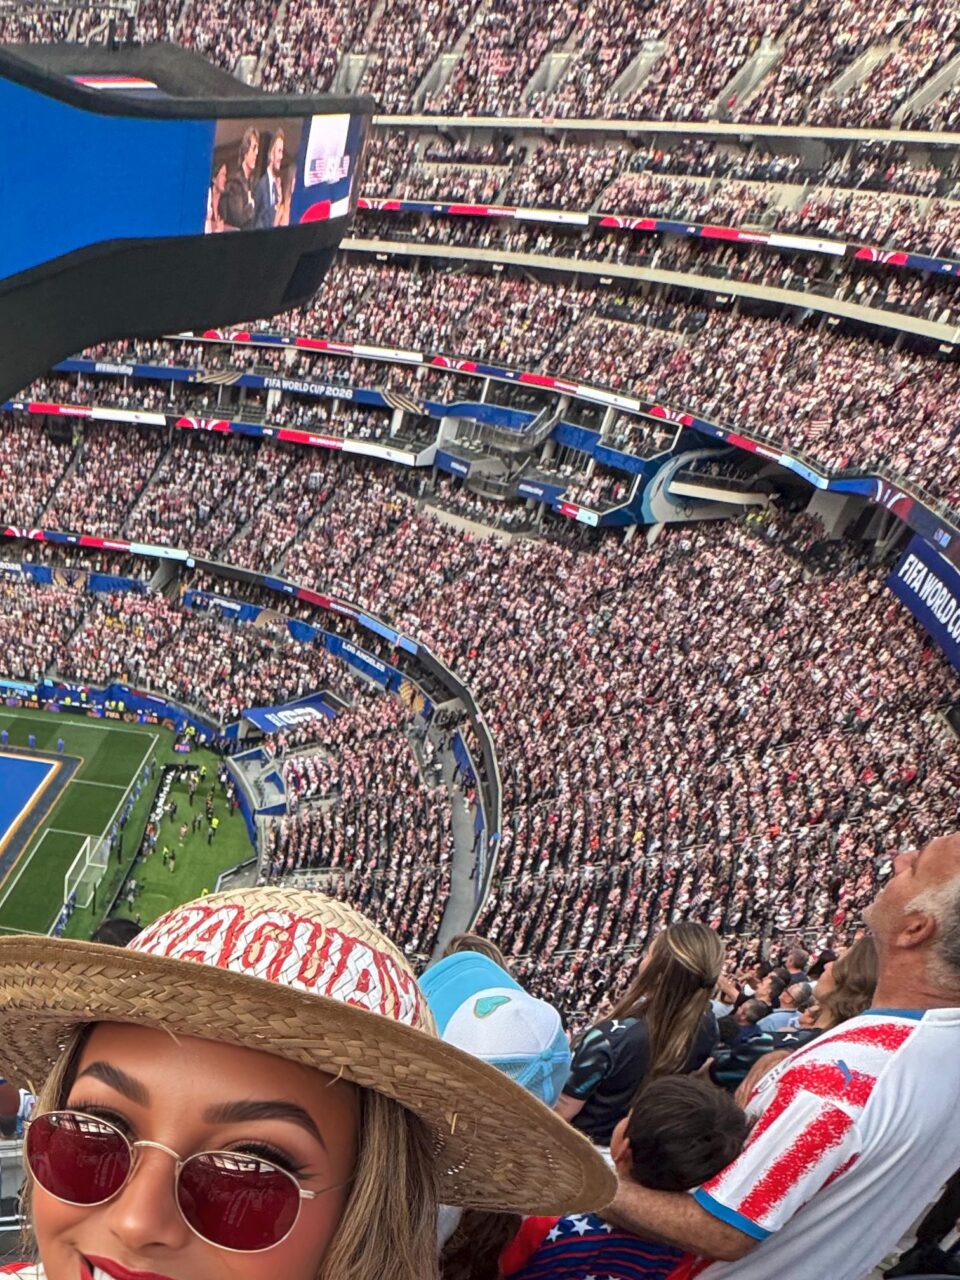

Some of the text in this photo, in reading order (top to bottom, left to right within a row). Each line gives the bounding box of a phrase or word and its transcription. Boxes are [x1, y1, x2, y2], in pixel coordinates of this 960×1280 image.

[264, 378, 353, 399] FIFA WORLD CUP 2026
[898, 553, 928, 594] FIFA
[919, 572, 958, 625] WORLD
[342, 641, 386, 672] LOS ANGELES
